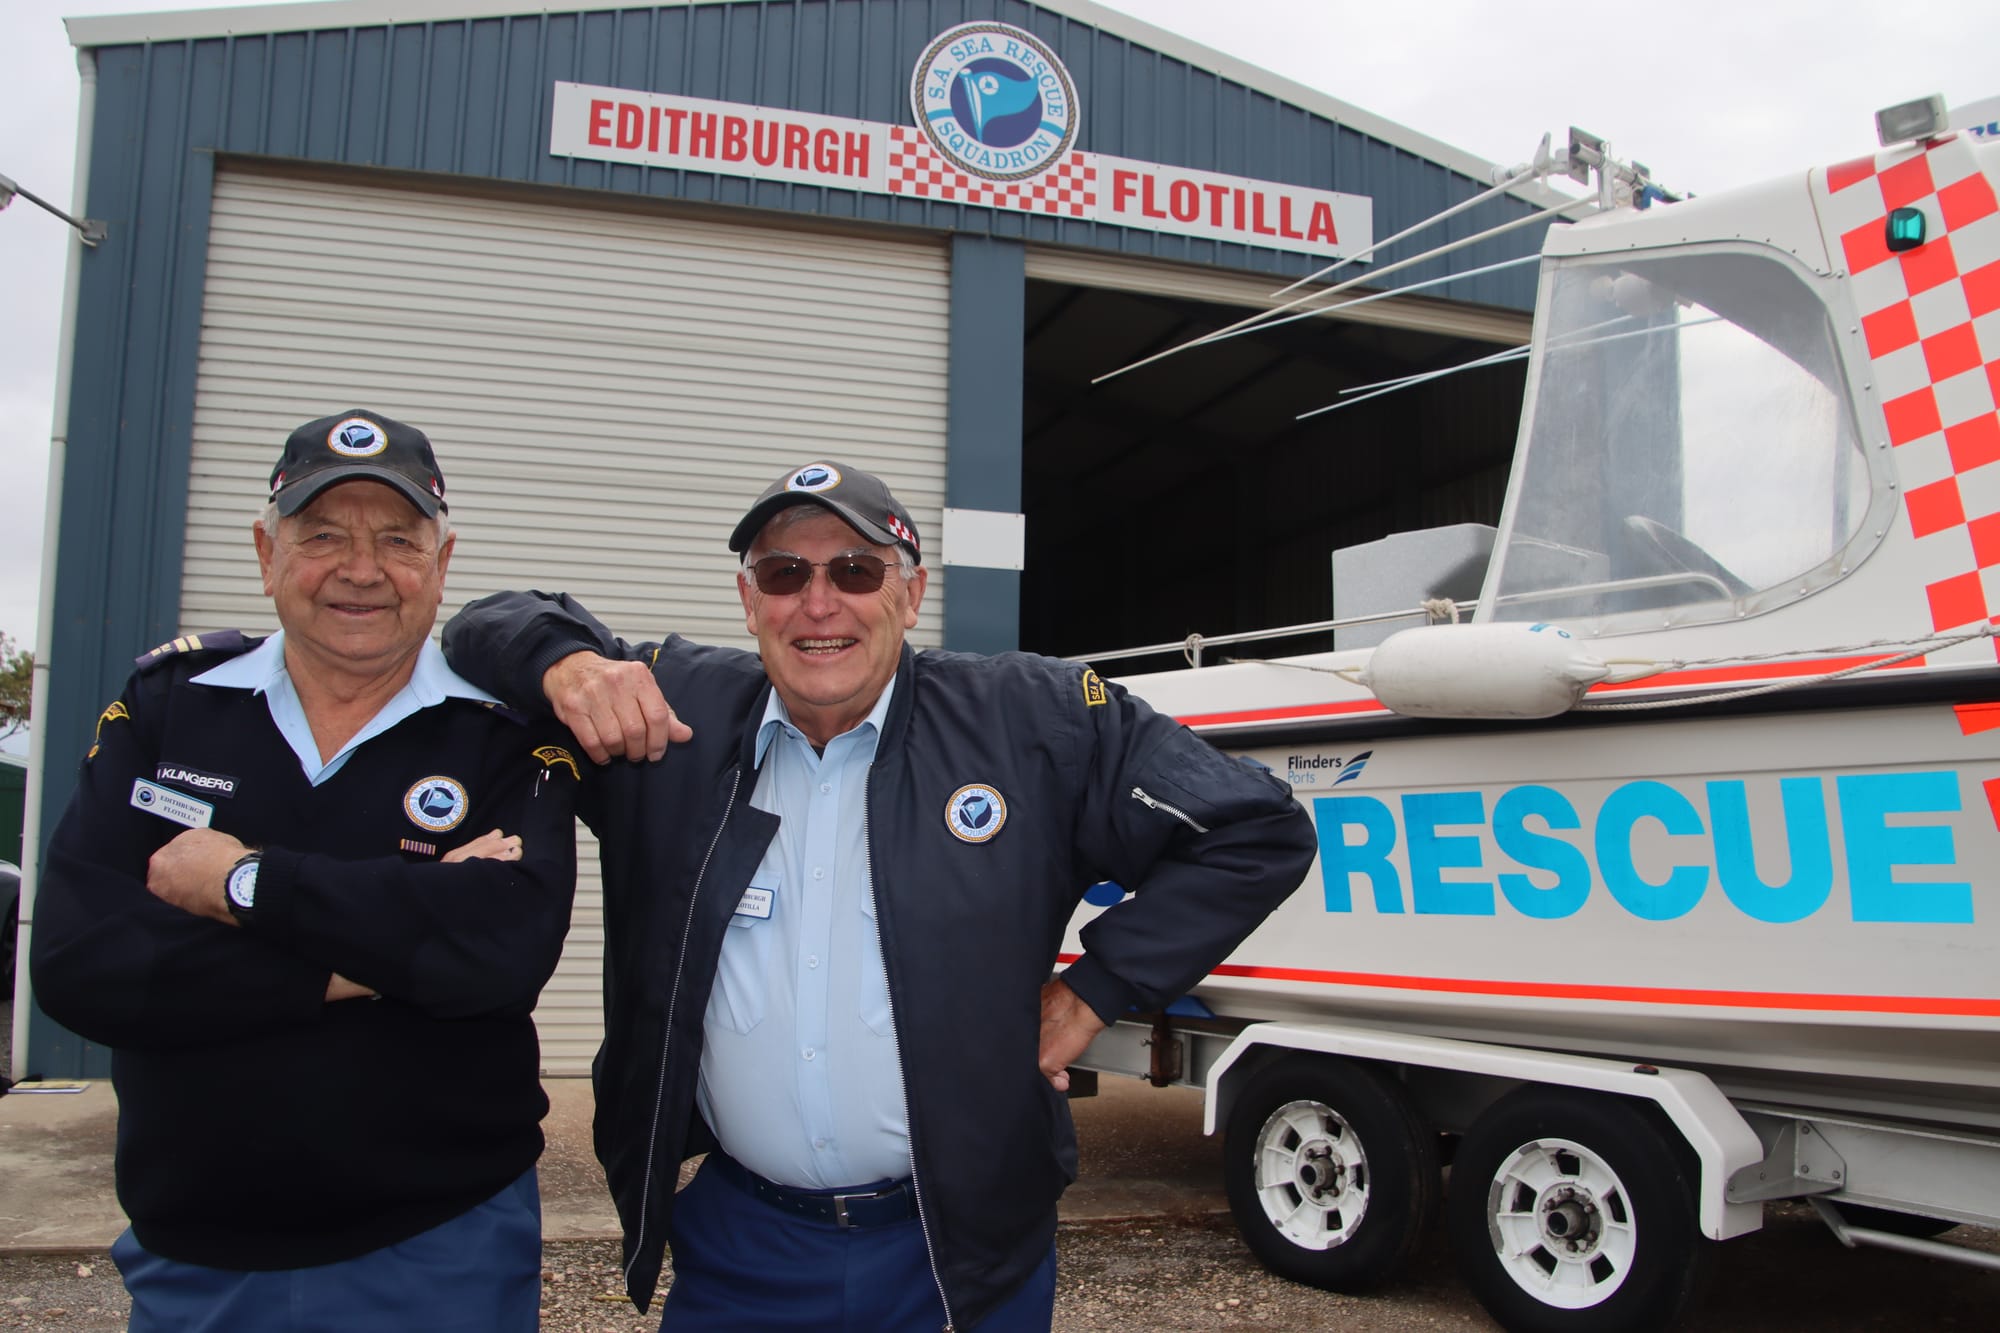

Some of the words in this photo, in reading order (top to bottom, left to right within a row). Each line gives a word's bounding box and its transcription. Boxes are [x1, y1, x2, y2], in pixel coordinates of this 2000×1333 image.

[950, 37, 995, 63] SEA
[1004, 40, 1064, 118] RESCUE
[588, 99, 870, 178] EDITHBURGH
[938, 121, 1052, 169] SQUADRON
[1113, 169, 1338, 245] FLOTILLA
[1288, 754, 1342, 770] Flinders
[162, 767, 234, 792] KLINGBERG
[1287, 769, 1316, 785] Ports
[160, 795, 205, 816] EDITHBURGH
[163, 805, 197, 822] FLOTILLA
[1312, 771, 1974, 923] RESCUE
[739, 902, 760, 910] OTILLA
